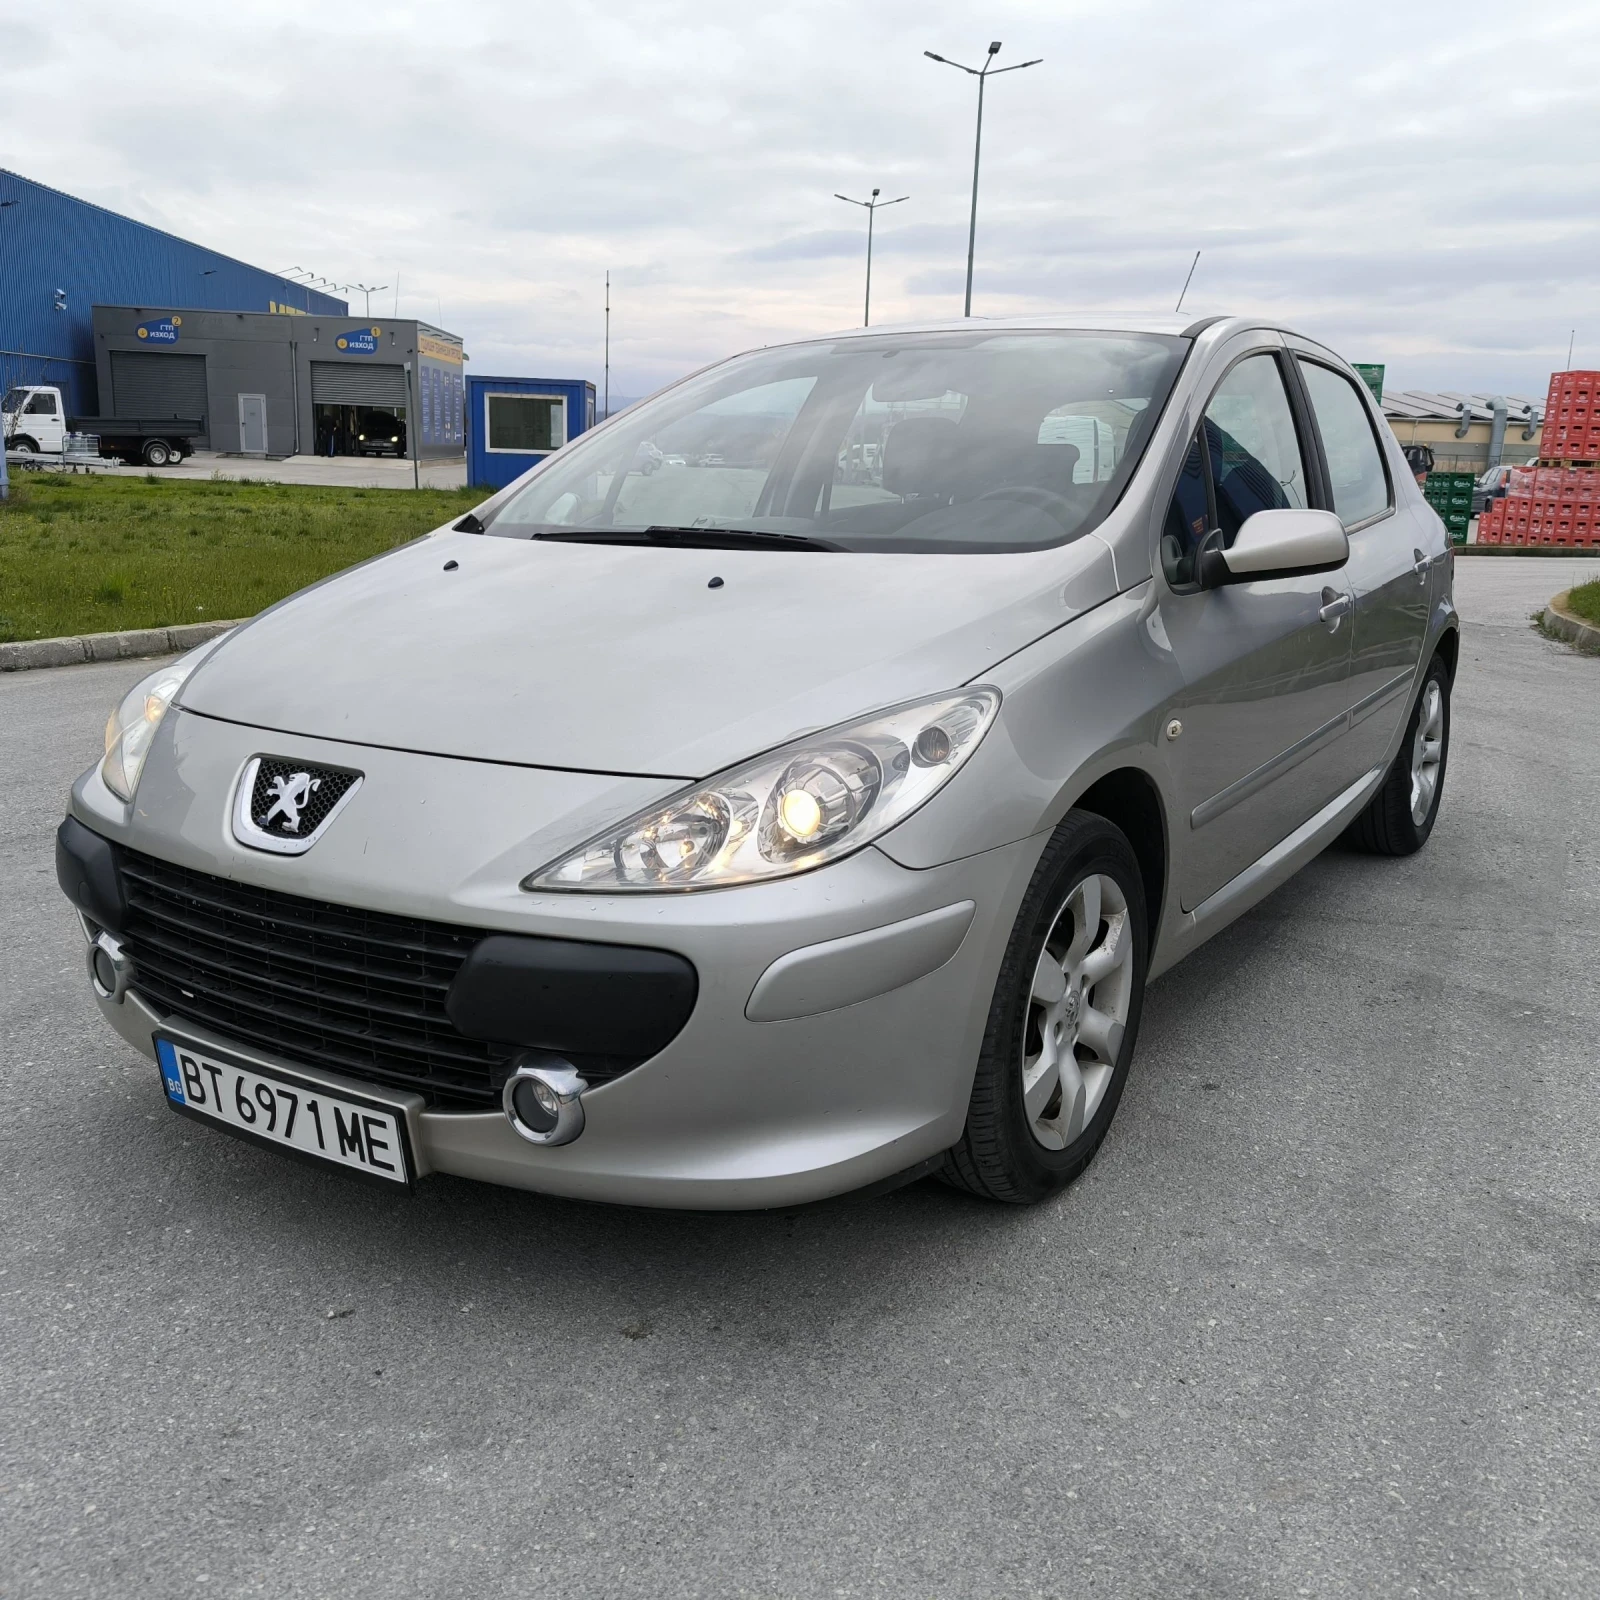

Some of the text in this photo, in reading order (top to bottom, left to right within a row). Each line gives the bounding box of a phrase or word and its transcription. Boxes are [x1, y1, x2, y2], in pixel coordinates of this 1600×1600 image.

[150, 331, 175, 339] ИЗХОД
[349, 342, 374, 350] ИЗХОД
[168, 1077, 182, 1095] BG
[180, 1054, 396, 1172] BT 6971 ME
